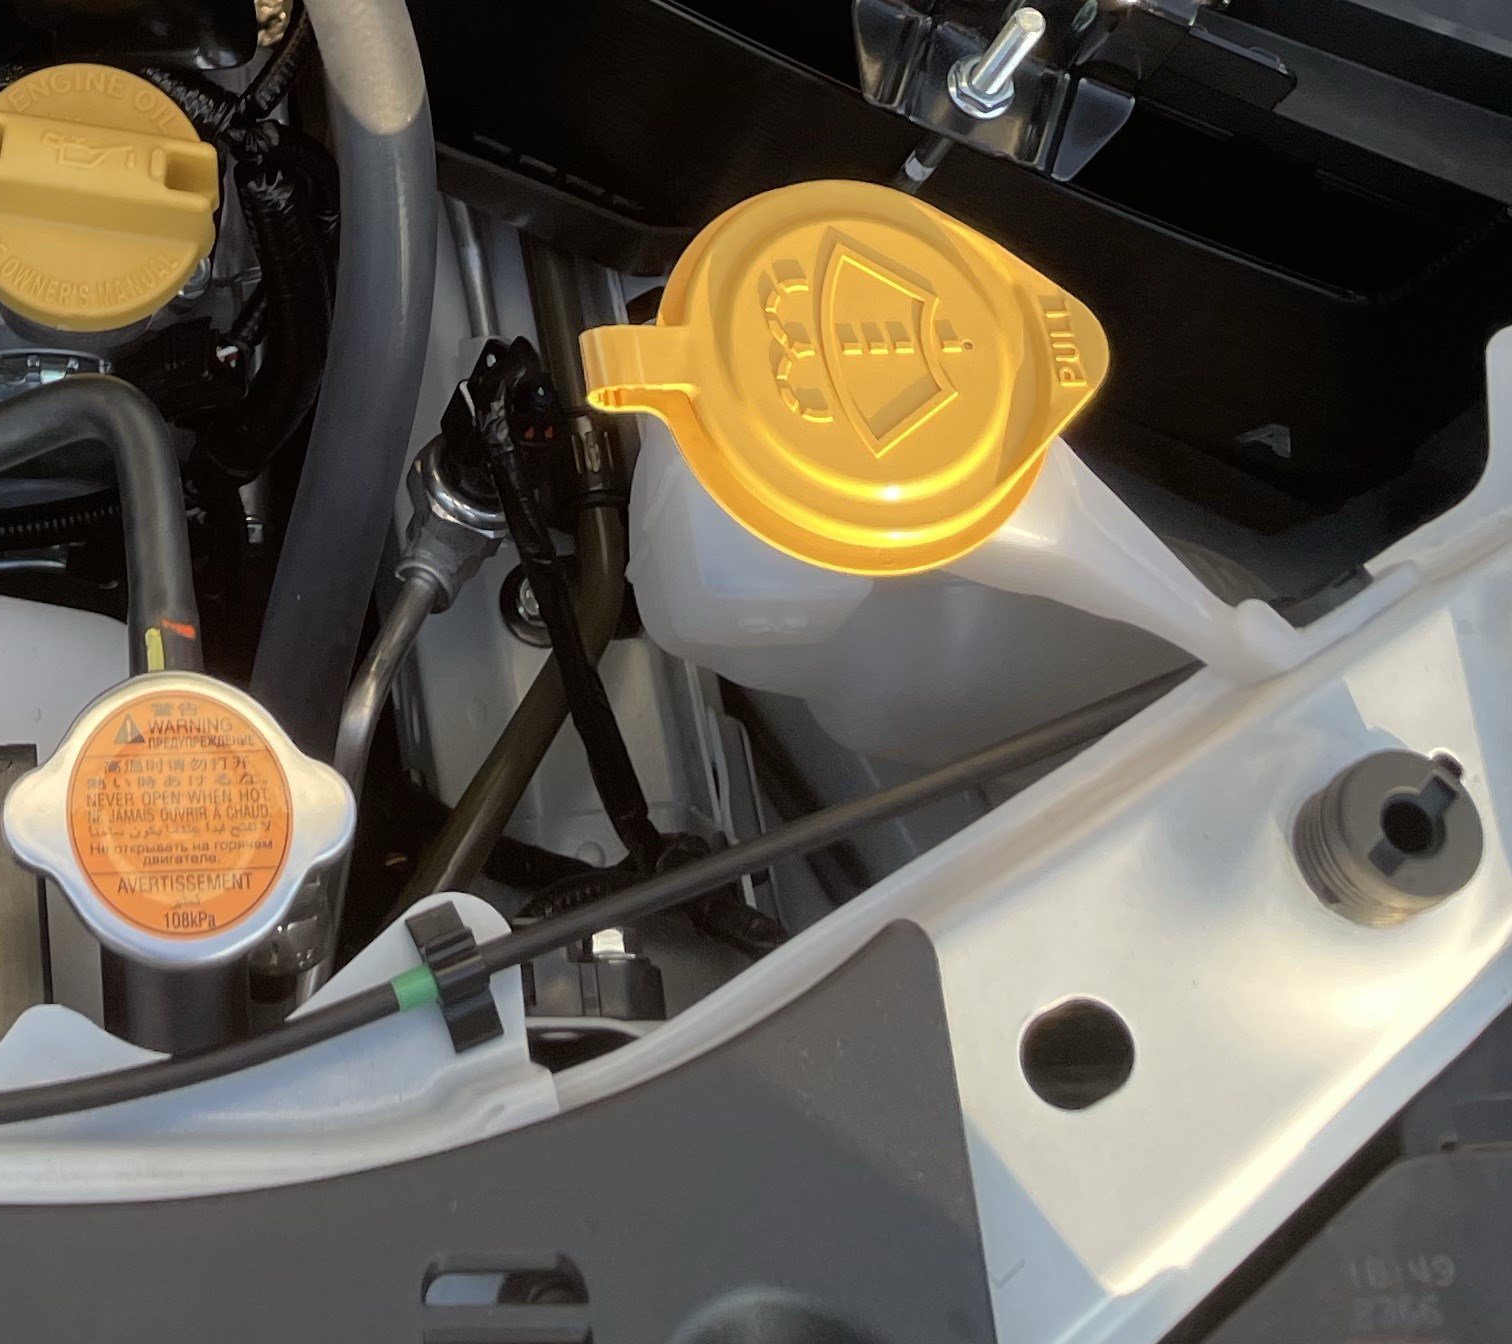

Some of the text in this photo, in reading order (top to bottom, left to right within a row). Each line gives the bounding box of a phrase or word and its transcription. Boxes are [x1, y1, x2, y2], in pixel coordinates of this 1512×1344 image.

[7, 69, 184, 134] ENGINE OIL
[0, 254, 89, 308] OWNER'S
[93, 251, 181, 306] MANUAL
[1044, 296, 1088, 388] PULL
[148, 718, 233, 735] WARNING
[148, 735, 255, 750] ПРЕДУПРЕЖДЕНИЕ
[87, 792, 134, 807] NEVER
[142, 790, 181, 806] OPEN
[188, 788, 232, 804] WHEN
[109, 809, 155, 824] JAMAIS
[160, 807, 209, 823] OUVRIR
[192, 842, 210, 851] на
[117, 871, 254, 894] AVERTISSEMENT
[164, 911, 217, 929] 108kPa
